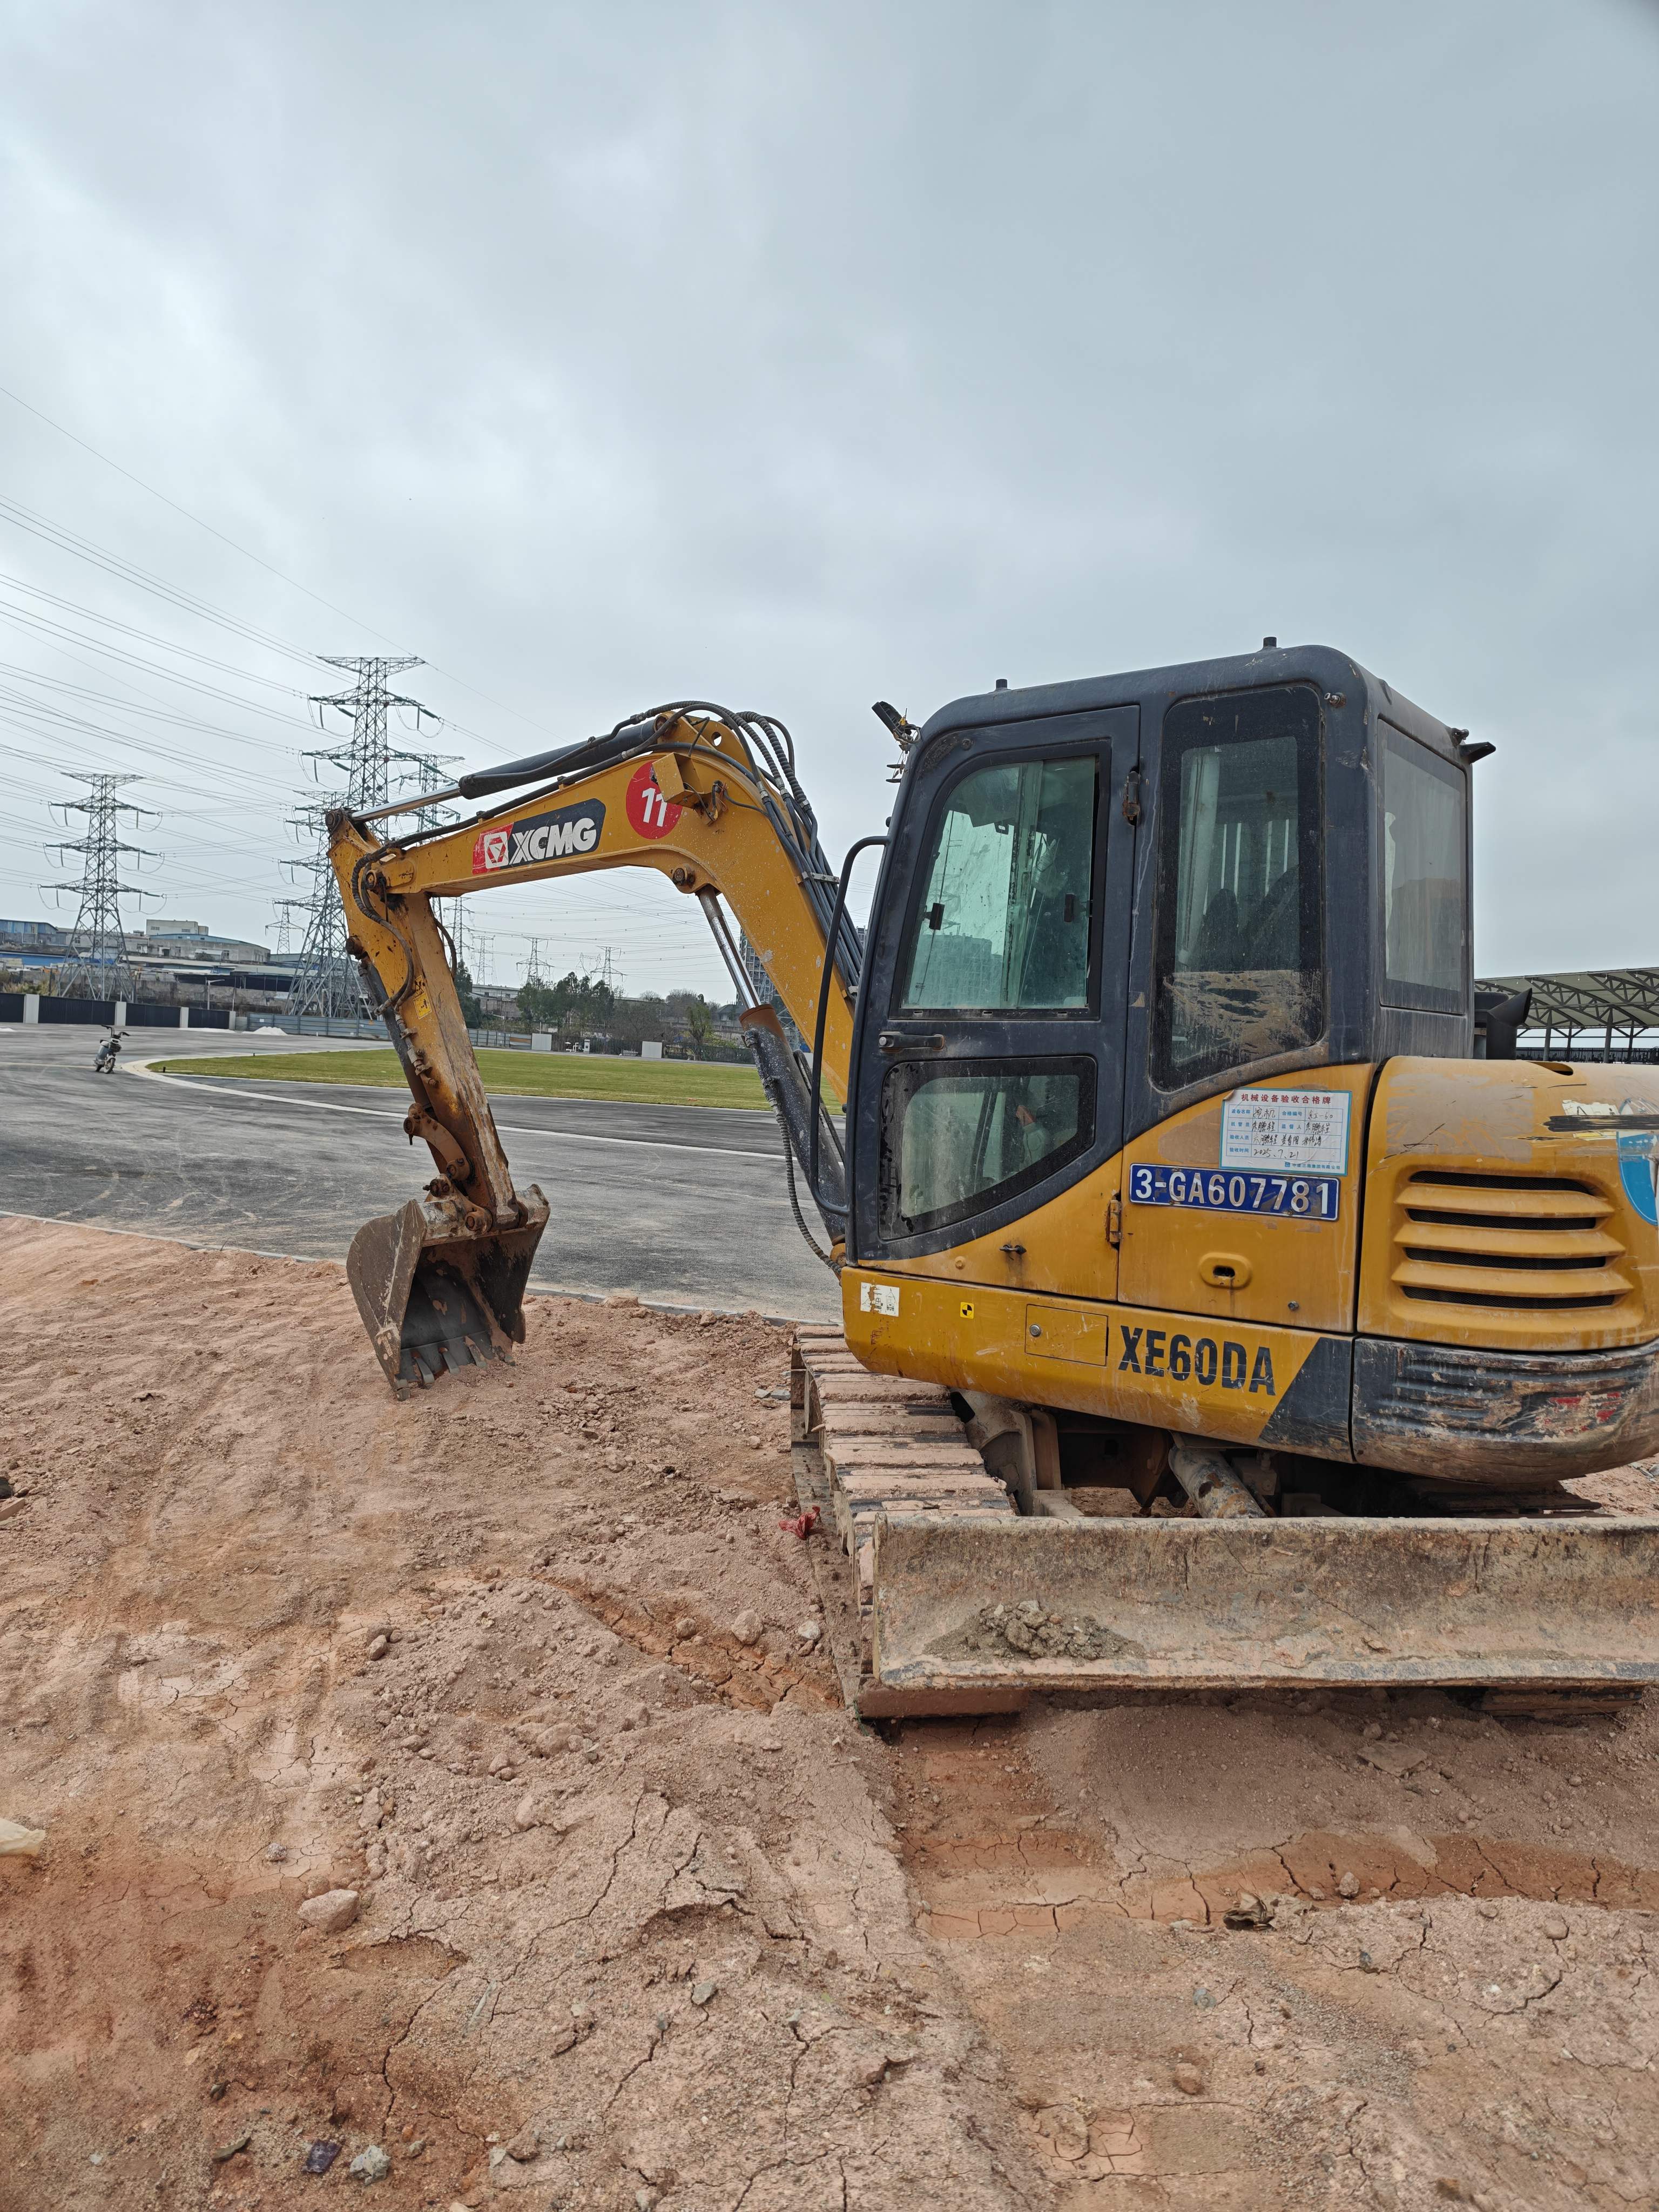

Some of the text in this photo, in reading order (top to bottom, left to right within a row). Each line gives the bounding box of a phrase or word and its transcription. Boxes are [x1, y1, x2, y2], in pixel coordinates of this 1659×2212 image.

[641, 787, 667, 827] 11
[509, 818, 597, 865] XCMG
[1241, 1094, 1331, 1104] 机械设备验收合格牌
[1135, 1169, 1328, 1214] 3-GA607781
[1118, 1325, 1276, 1396] XE60DA
